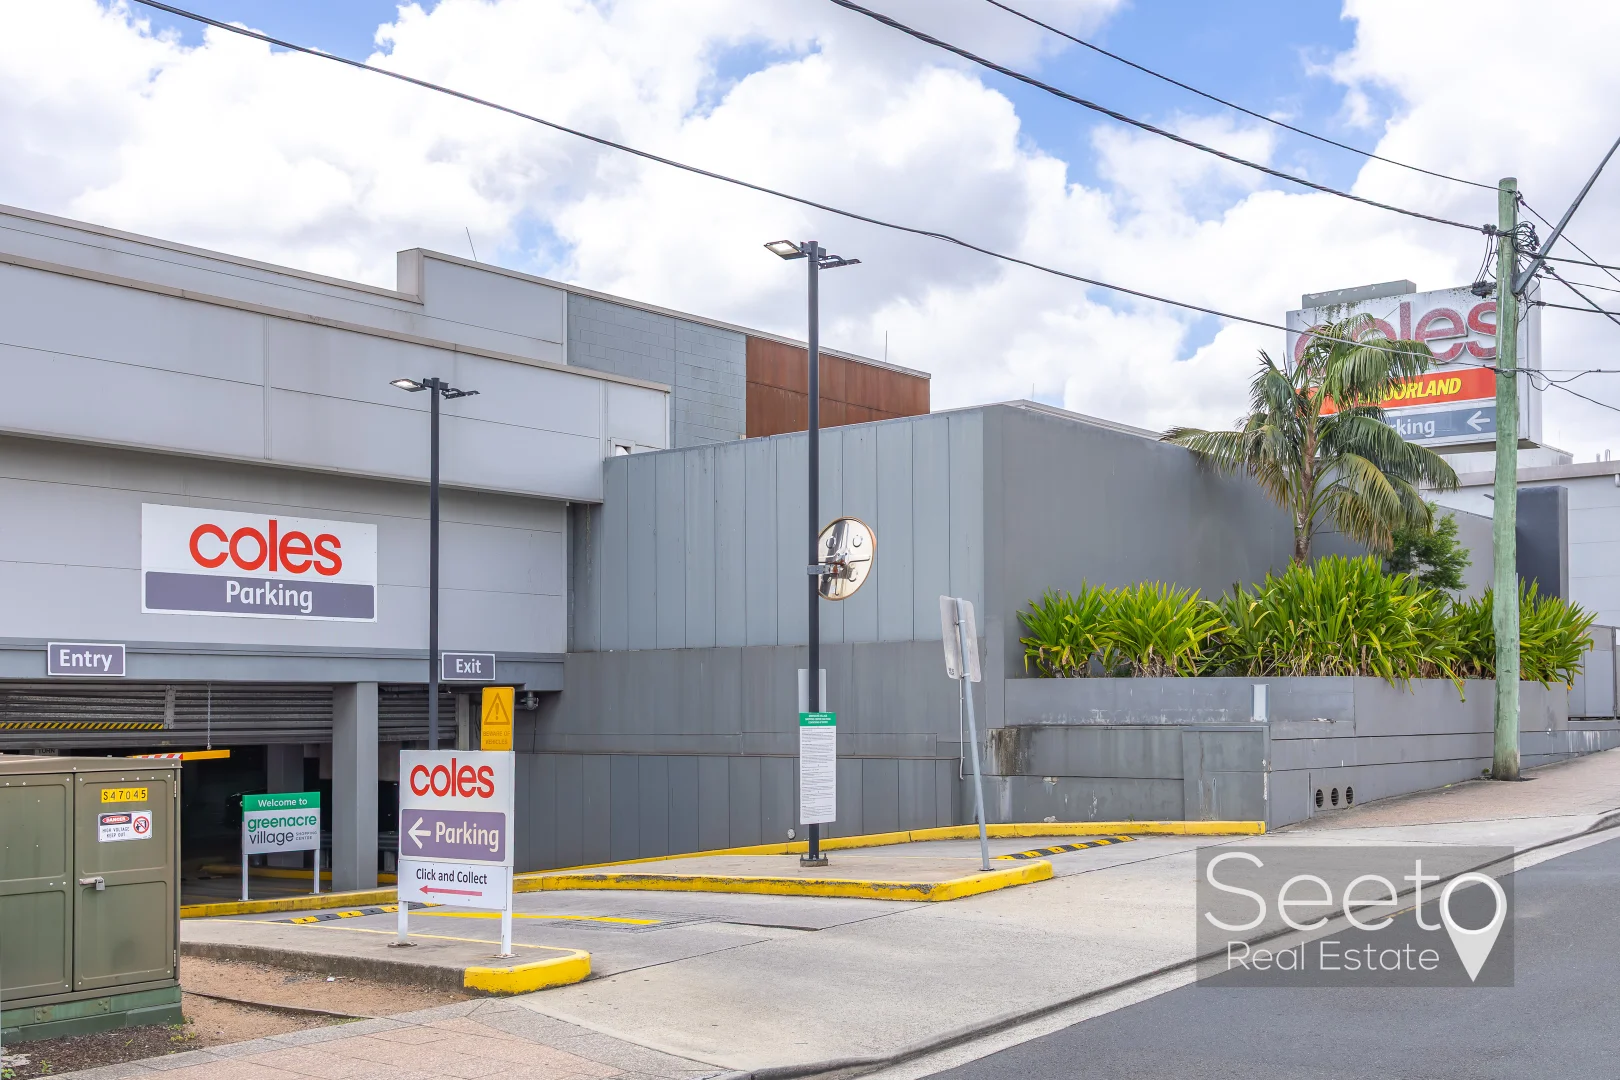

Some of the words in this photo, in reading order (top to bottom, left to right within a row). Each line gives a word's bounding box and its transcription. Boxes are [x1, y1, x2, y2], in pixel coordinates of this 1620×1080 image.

[1345, 377, 1462, 407] UORLAND
[1390, 418, 1436, 438] rking
[189, 519, 343, 577] coles
[226, 580, 314, 614] Parking
[59, 648, 113, 672] Entry
[455, 658, 482, 674] Exit
[410, 758, 495, 799] coles
[103, 789, 147, 801] S47045
[258, 799, 296, 807] Welcome
[248, 815, 317, 832] greenacre
[249, 831, 294, 846] village
[435, 821, 499, 853] Parking
[416, 868, 437, 881] Click
[438, 870, 455, 882] and
[456, 871, 488, 885] Collect
